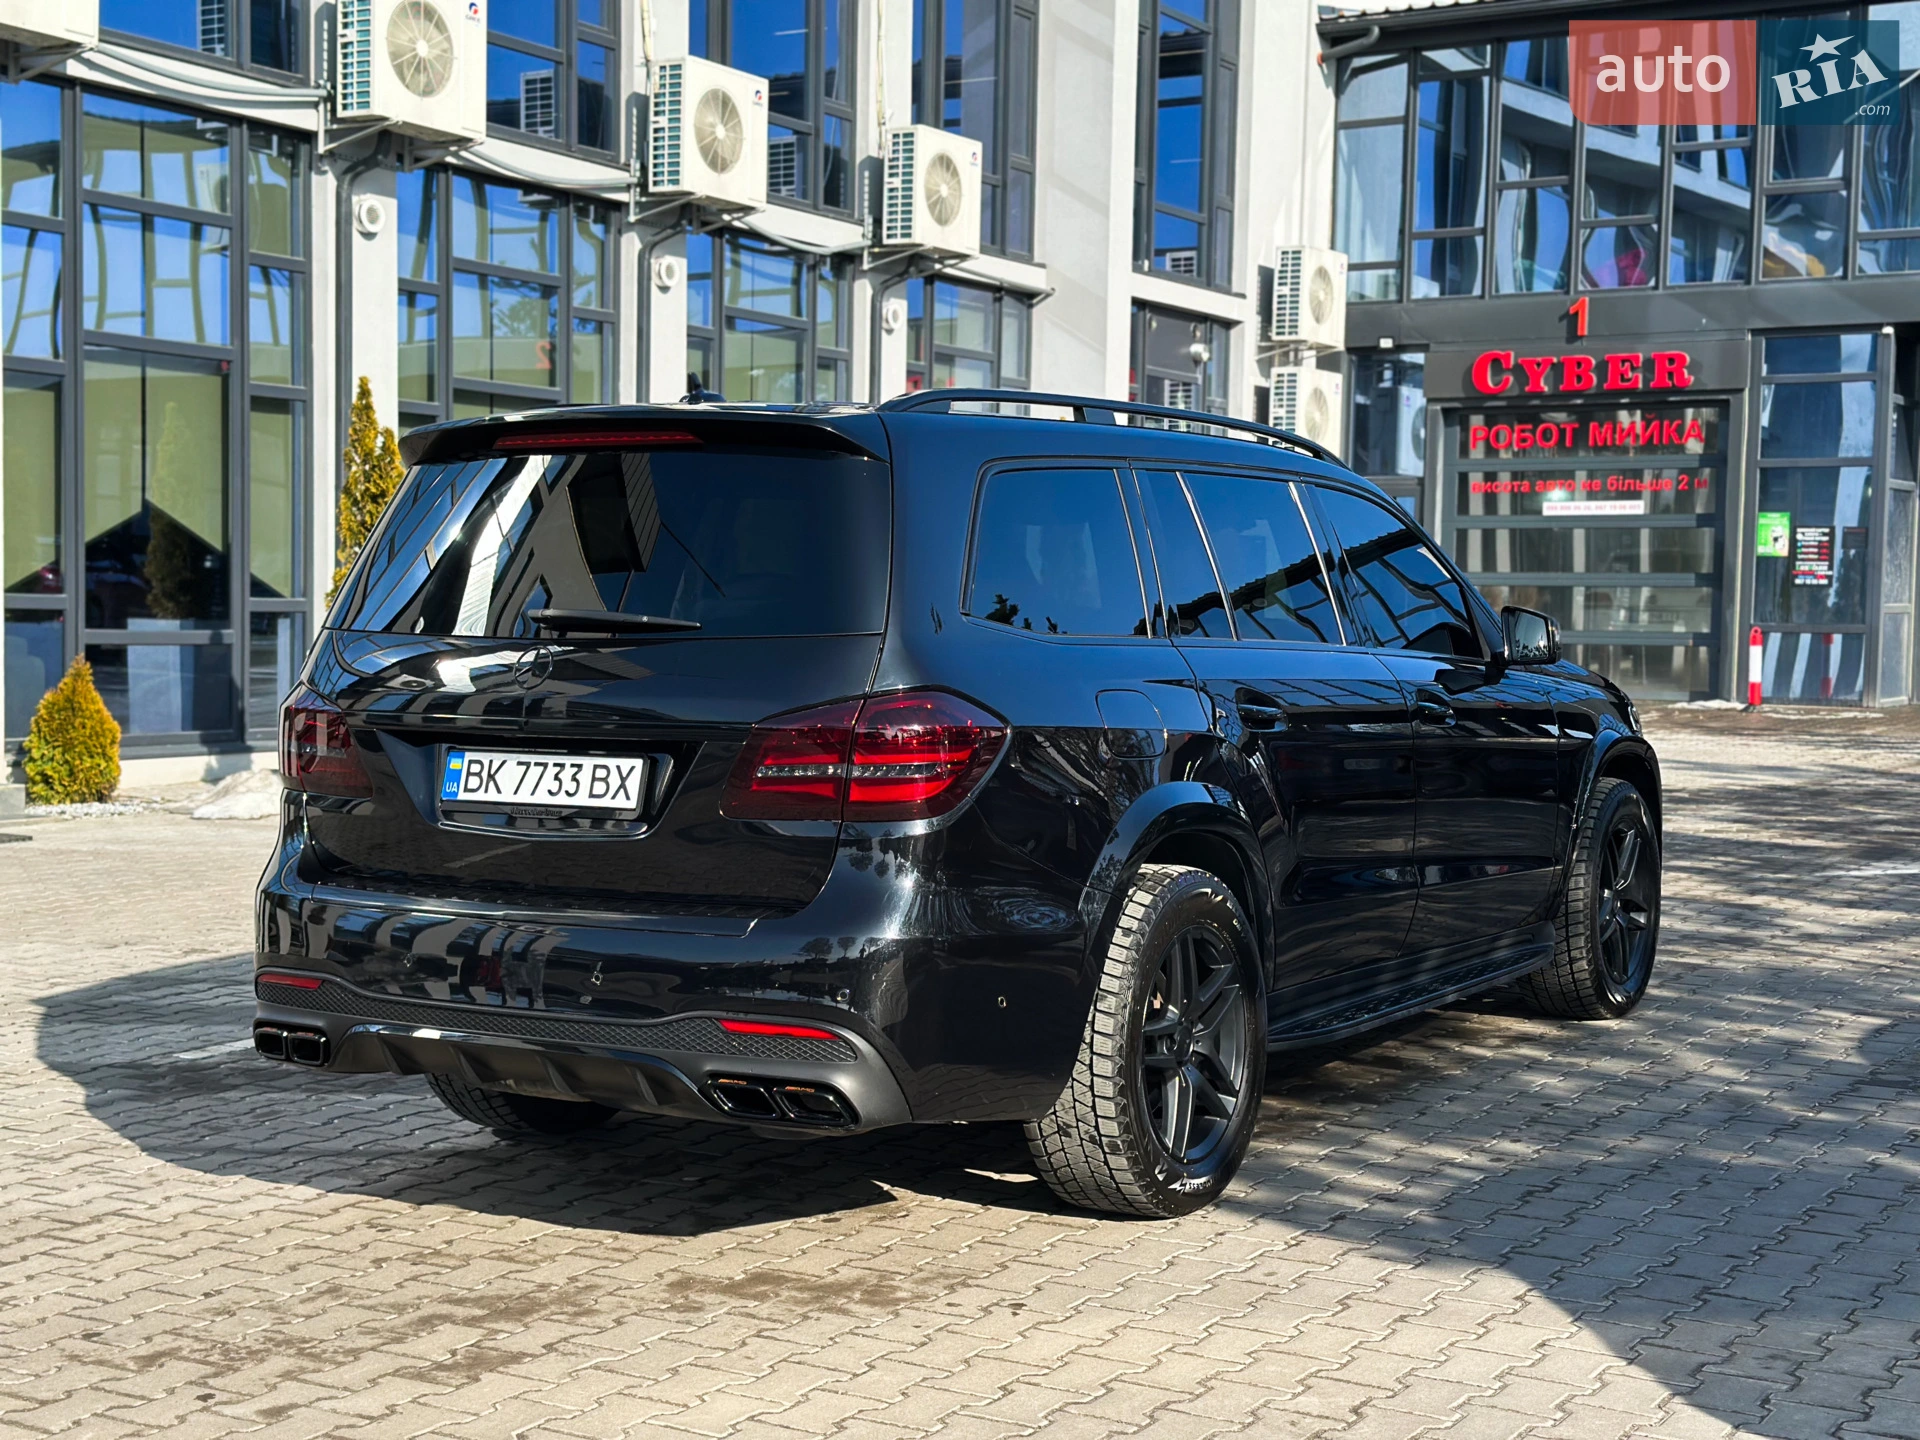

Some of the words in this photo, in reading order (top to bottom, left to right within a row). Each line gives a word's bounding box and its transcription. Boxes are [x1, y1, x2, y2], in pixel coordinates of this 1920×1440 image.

[1569, 296, 1589, 337] 1
[1472, 350, 1694, 394] CYBER
[1469, 421, 1579, 450] РОБОТ
[1588, 413, 1706, 447] МИЙКА
[1471, 480, 1531, 494] висота
[1535, 479, 1576, 493] авто
[1581, 478, 1603, 492] не
[1607, 475, 1674, 492] більше
[1677, 474, 1690, 491] 2
[446, 781, 458, 793] UA
[463, 758, 507, 795] BK
[513, 761, 584, 797] 7733
[588, 764, 636, 801] BX
